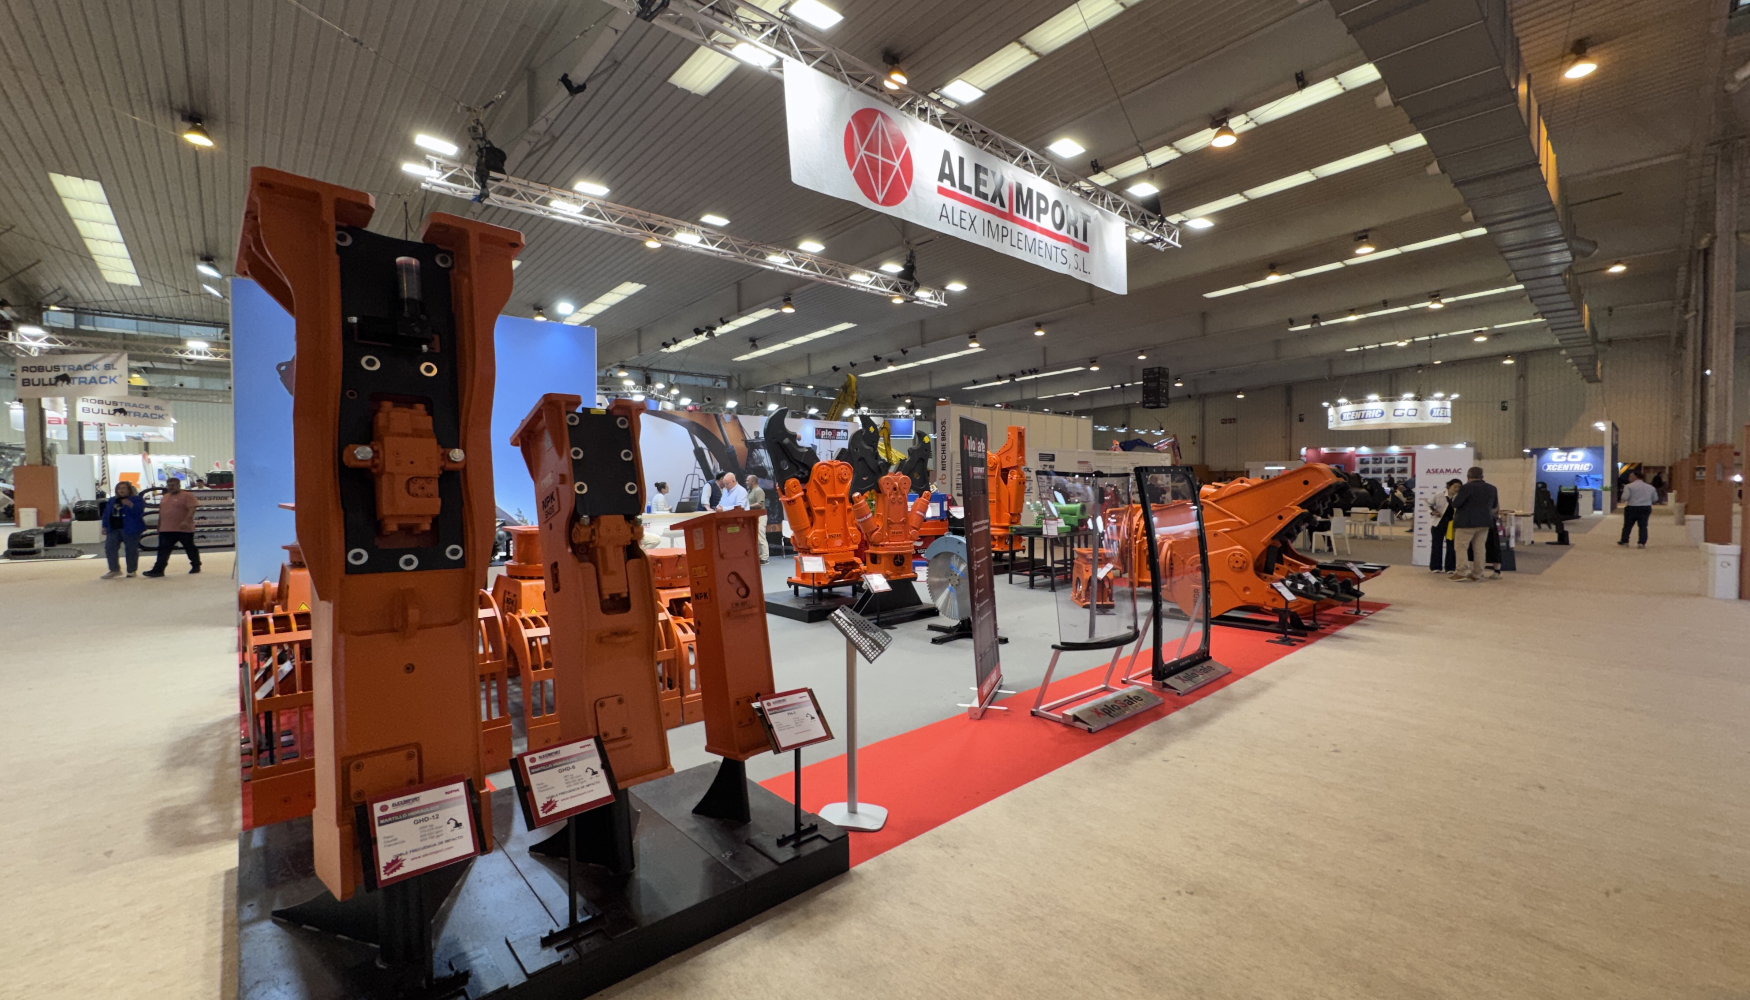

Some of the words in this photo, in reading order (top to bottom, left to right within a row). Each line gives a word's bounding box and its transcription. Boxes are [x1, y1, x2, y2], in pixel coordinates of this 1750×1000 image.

[938, 149, 1092, 243] ALEXIMPORT
[939, 203, 977, 234] ALEX
[982, 217, 1072, 269] IMPLEMENTS,
[1073, 253, 1091, 275] S.L.
[21, 364, 99, 373] ROBUSTRACK
[103, 363, 117, 371] SL
[81, 397, 151, 410] ROBUSTRACK
[1342, 409, 1383, 420] XCENTRIC
[1393, 408, 1418, 417] GO
[815, 428, 848, 439] XploSafe
[1551, 451, 1584, 462] GO
[1545, 463, 1590, 471] XCENTRIC
[542, 490, 556, 511] NPK
[695, 592, 709, 600] NPK
[1174, 664, 1216, 684] XploSafe
[1089, 695, 1144, 718] XploSafe
[413, 813, 440, 825] GHD-12
